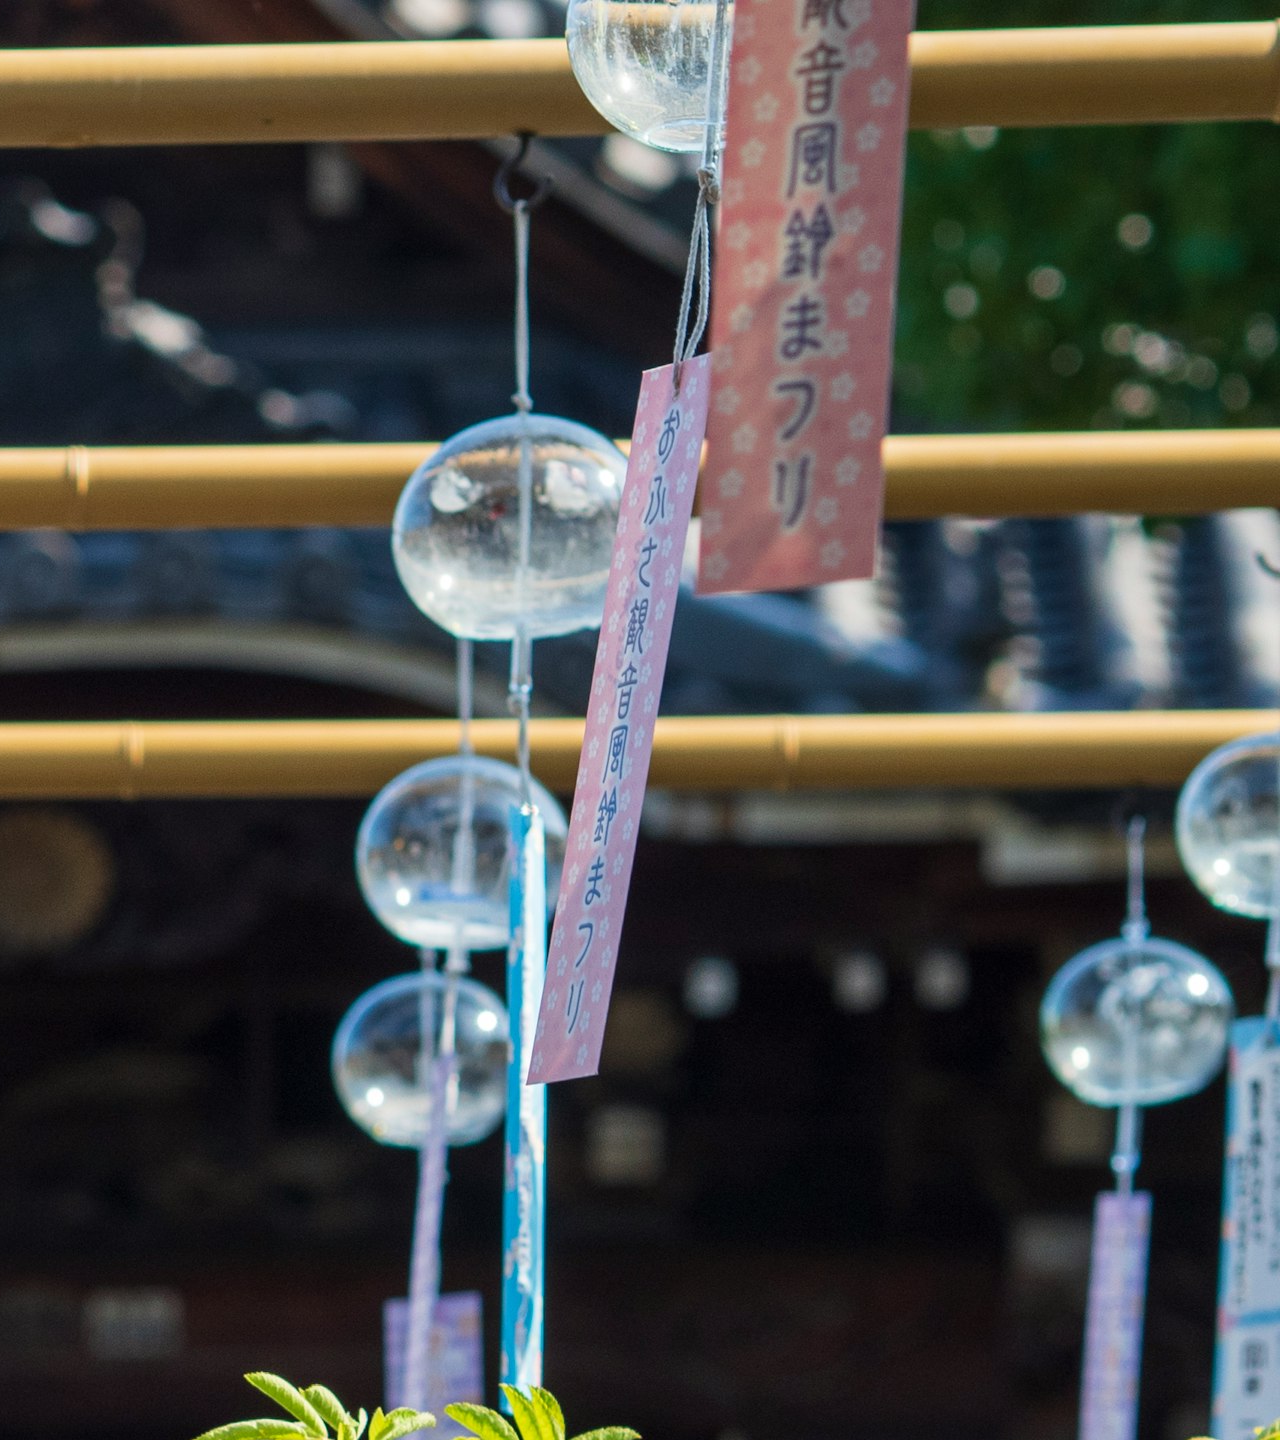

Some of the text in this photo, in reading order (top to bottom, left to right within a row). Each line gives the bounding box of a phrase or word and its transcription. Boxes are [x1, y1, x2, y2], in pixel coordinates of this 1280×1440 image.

[565, 409, 682, 1036] おふさ観音風鈴まつり
